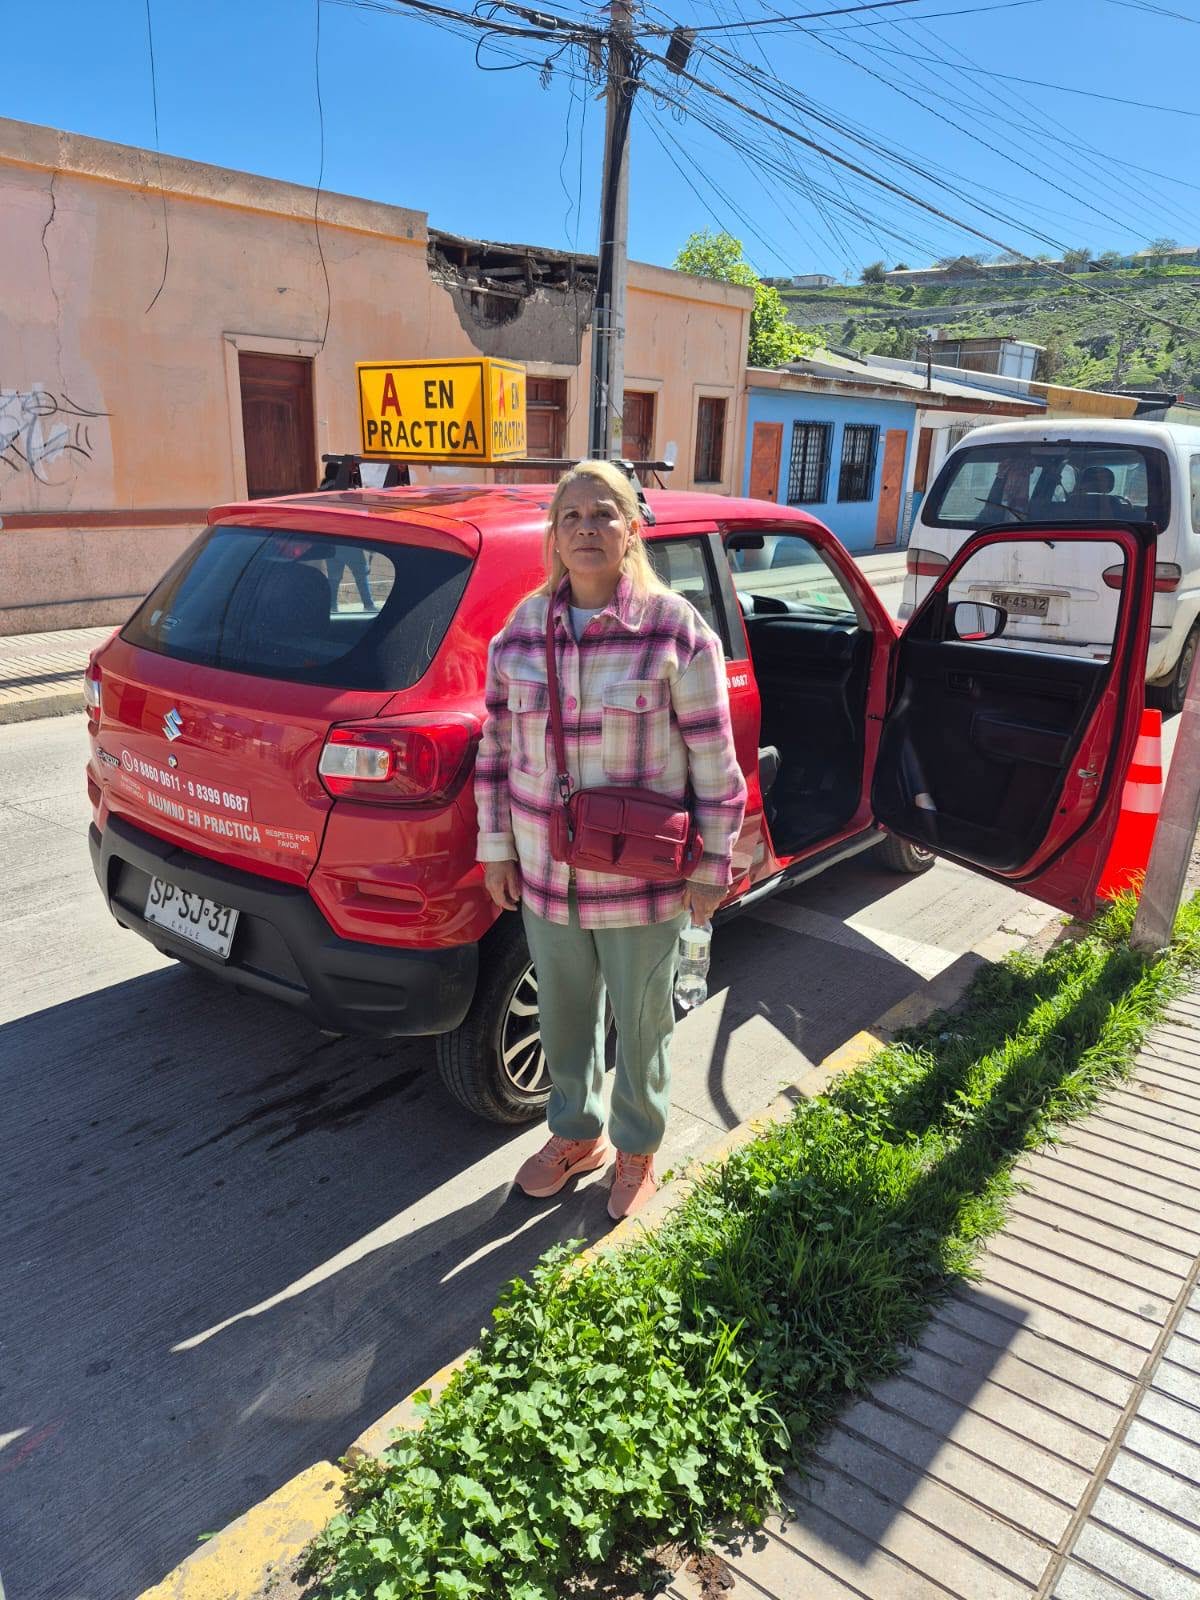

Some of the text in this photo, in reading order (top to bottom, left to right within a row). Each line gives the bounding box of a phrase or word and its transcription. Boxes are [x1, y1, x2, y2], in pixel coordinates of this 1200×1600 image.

[380, 372, 454, 417] A EN
[498, 371, 506, 417] A
[366, 419, 479, 450] PRACTICA
[493, 420, 525, 449] PRACTICA
[133, 758, 139, 773] 9
[160, 770, 181, 792] 0611
[187, 781, 195, 797] 9
[196, 784, 221, 805] 8399
[222, 792, 249, 813] 0687
[147, 791, 261, 843] ALUMNO EN PRACTICA
[277, 840, 299, 849] FAVOR
[295, 834, 310, 842] POR
